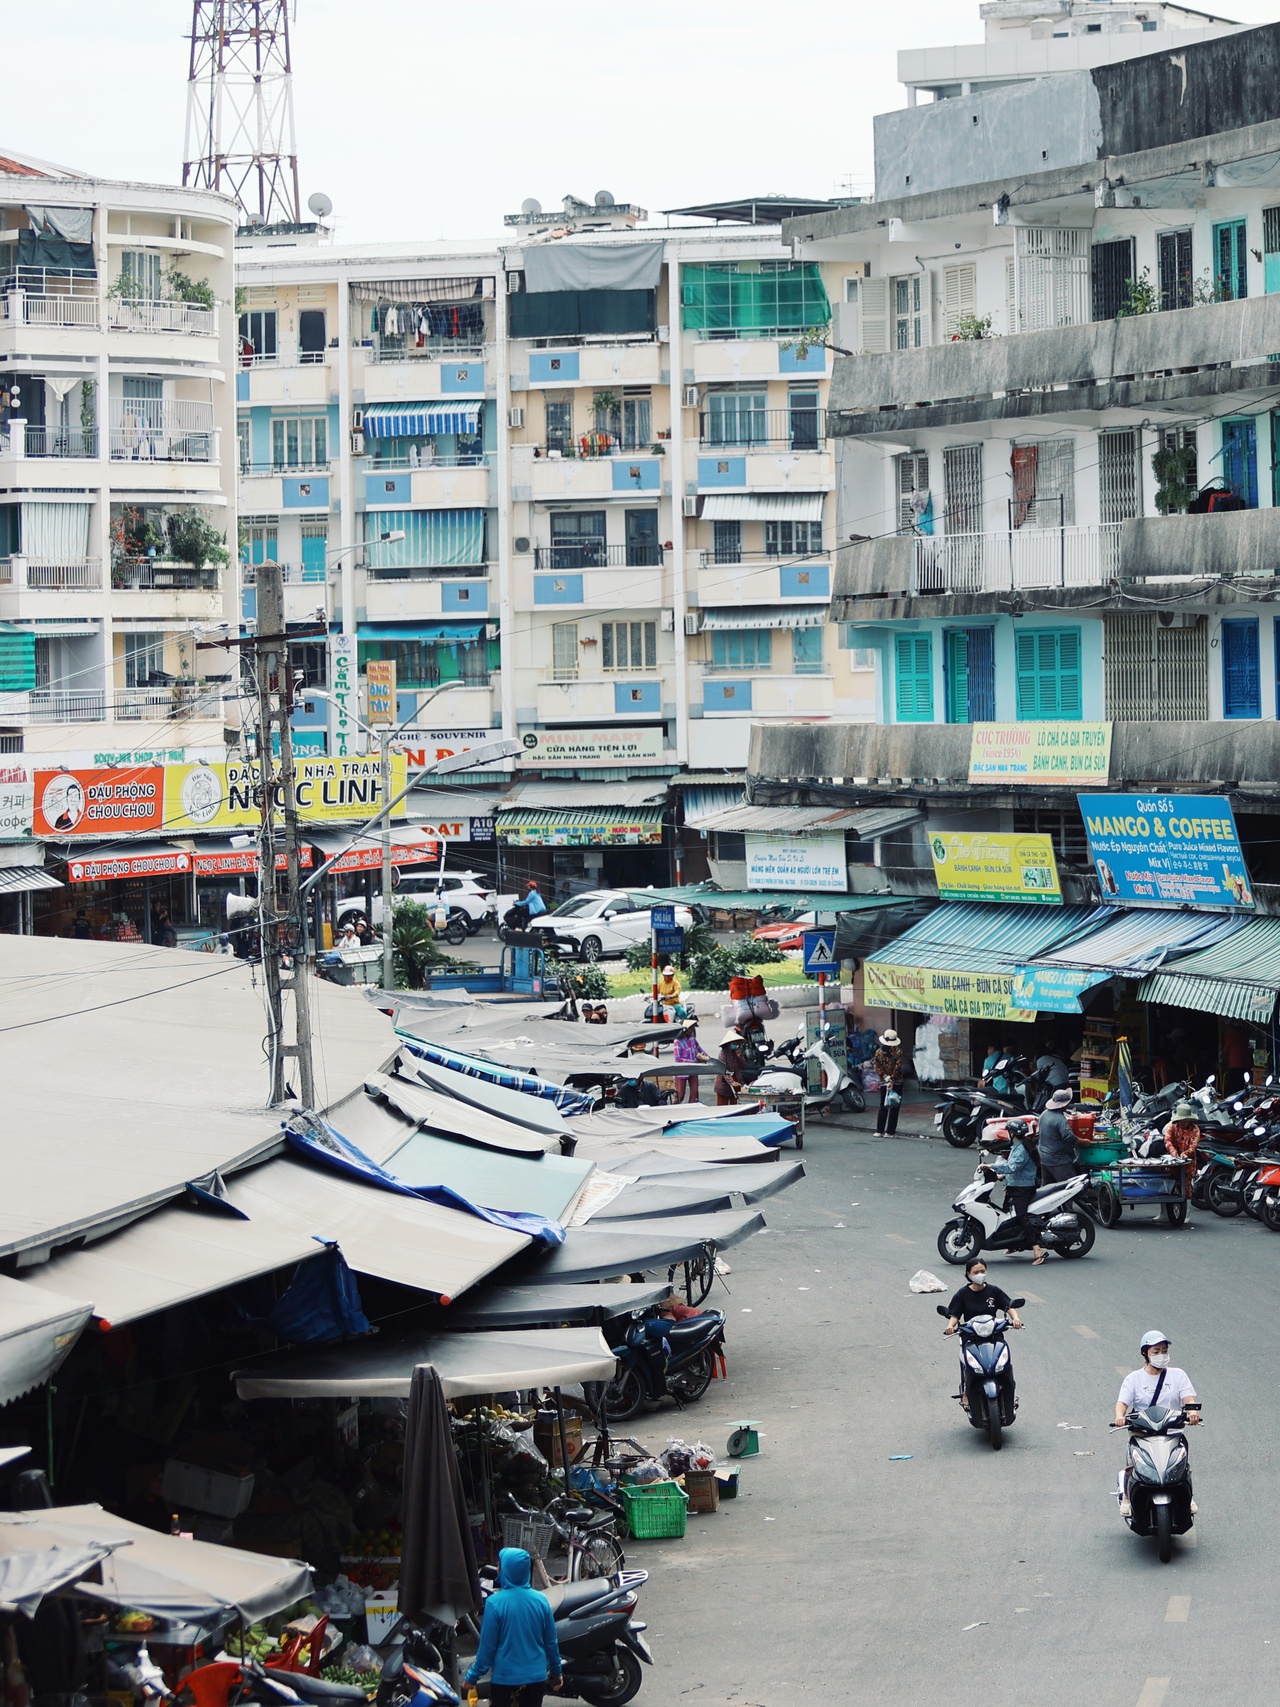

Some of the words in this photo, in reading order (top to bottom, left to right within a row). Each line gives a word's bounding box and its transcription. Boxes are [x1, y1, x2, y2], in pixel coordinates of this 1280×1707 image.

[370, 682, 389, 696] ÔNG
[370, 698, 390, 713] TÂY
[430, 731, 487, 741] SOUVENIR
[539, 734, 586, 743] MINI
[591, 732, 644, 742] MART
[976, 727, 994, 745] CÚC
[995, 726, 1031, 745] TRƯỜNG
[1046, 725, 1060, 746] CHẢ
[1060, 728, 1069, 746] CÁ
[1070, 731, 1080, 746] GIA
[546, 744, 566, 753] CỬA
[569, 744, 595, 753] HÀNG
[599, 744, 619, 752] TIỆN
[983, 748, 1002, 759] (since
[1003, 748, 1021, 759] 1954)
[1009, 764, 1028, 772] TRANG
[1033, 751, 1050, 770] BÁNH
[1070, 751, 1083, 770] BÚN
[1084, 751, 1093, 770] CÁ
[228, 763, 259, 785] ĐẶC
[304, 764, 335, 780] NHA
[88, 782, 112, 802] ĐẬU
[115, 781, 156, 801] PHỘNG
[228, 782, 313, 815] NỌC
[3, 795, 25, 810] 커피
[1137, 800, 1157, 814] Quán
[1157, 797, 1168, 812] Số
[1168, 801, 1174, 813] 5
[473, 819, 493, 828] A10
[1087, 816, 1151, 838] MANGO
[1153, 817, 1166, 838] &
[1168, 818, 1236, 840] COFFEE
[1121, 842, 1149, 855] Nguyên
[1149, 840, 1168, 854] Chất
[1168, 843, 1181, 851] Pure
[1181, 843, 1198, 851] Juice
[1198, 843, 1216, 852] Mixed
[1217, 844, 1239, 853] Flavors
[85, 861, 101, 879] ĐẬU
[102, 859, 130, 877] PHỘNG
[197, 859, 217, 873] NGỌC
[218, 858, 235, 869] LINH
[831, 867, 840, 875] EM
[1148, 857, 1161, 869] Mix
[1161, 858, 1172, 871] Vị
[932, 972, 951, 990] BÁNH
[951, 976, 971, 992] CANH
[976, 975, 991, 994] BÚN
[992, 976, 1002, 995] CÁ
[1034, 970, 1059, 984] MANGO
[944, 994, 958, 1014] CHẢ
[958, 997, 969, 1015] CÁ
[969, 1000, 981, 1015] GIA
